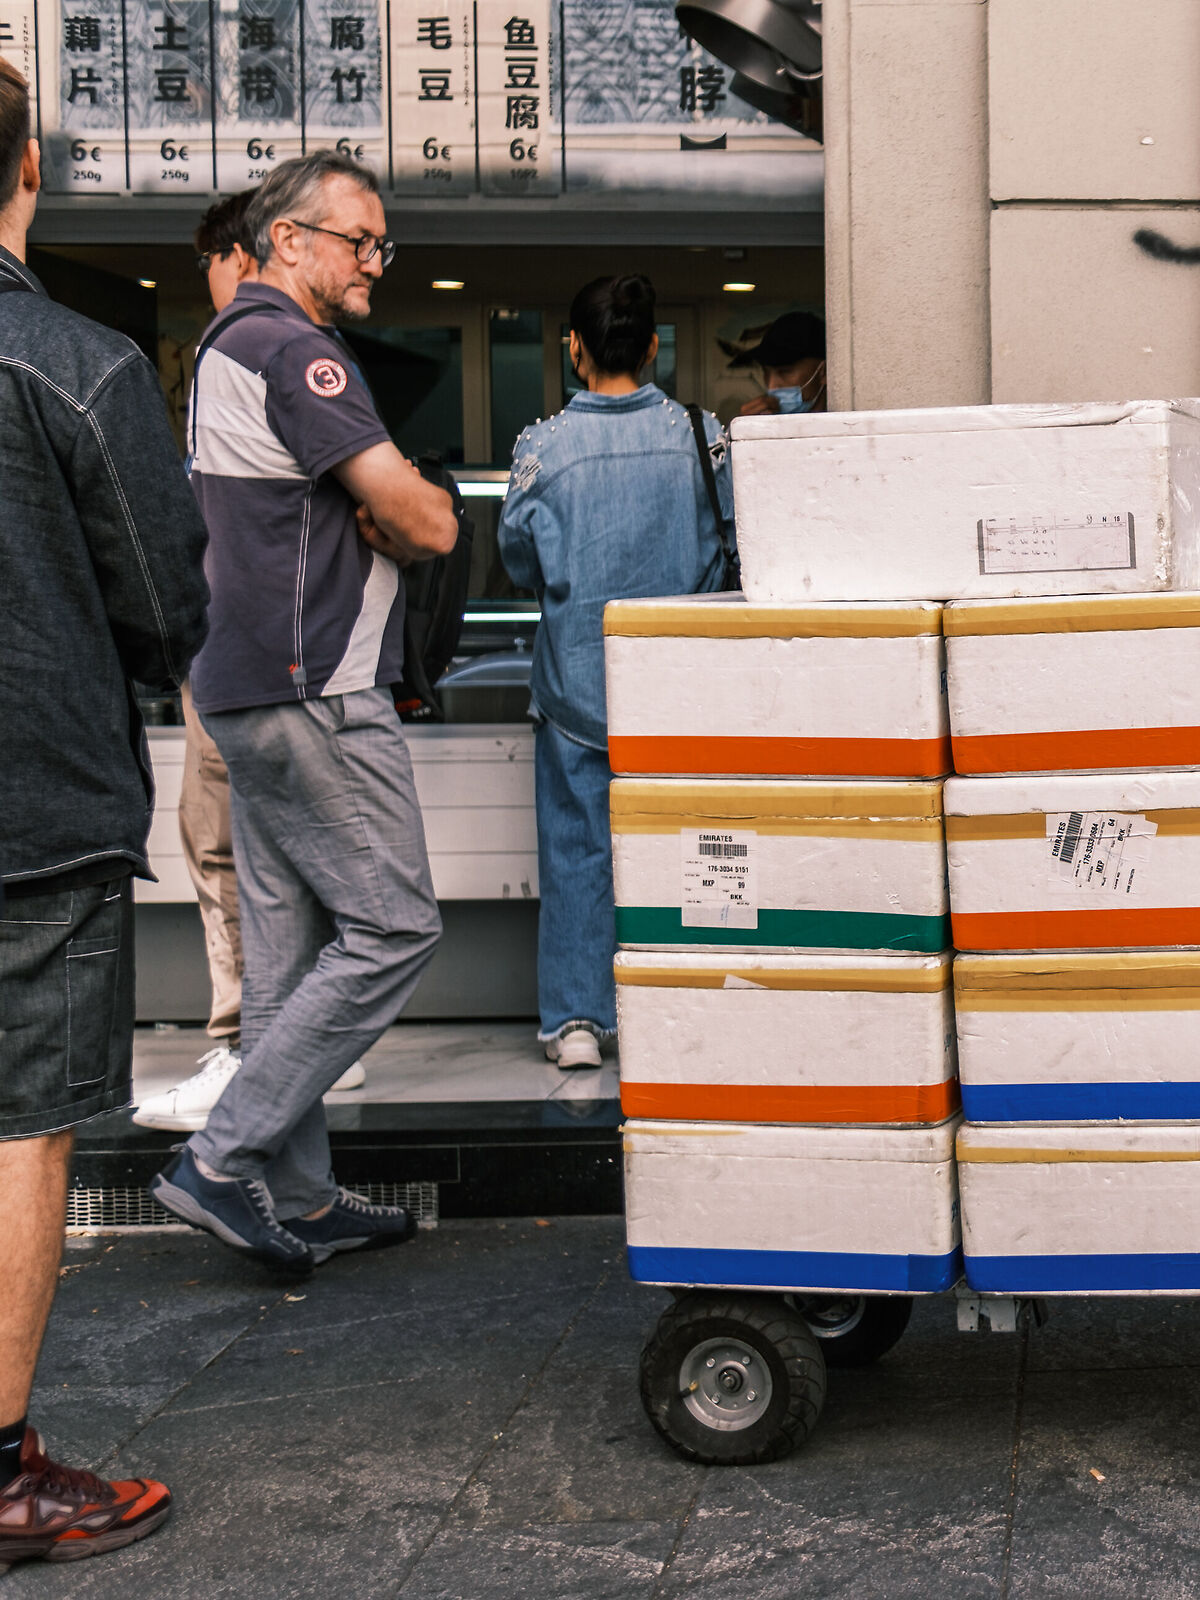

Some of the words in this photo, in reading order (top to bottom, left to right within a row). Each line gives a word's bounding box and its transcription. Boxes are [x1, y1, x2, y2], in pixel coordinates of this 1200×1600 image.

[65, 16, 102, 104] 藕片
[153, 16, 190, 102] 土豆
[330, 15, 366, 103] 腐竹
[417, 16, 453, 101] 毛豆
[504, 16, 539, 129] 鱼豆腐
[71, 139, 101, 162] 6€
[160, 139, 189, 161] 6€
[247, 138, 275, 160] 6€
[423, 137, 451, 161] 6€
[510, 138, 538, 161] 6€
[73, 170, 102, 182] 250g
[161, 170, 189, 181] 250g
[699, 834, 733, 842] EMIRATES
[1052, 821, 1067, 857] EMIRATES
[702, 879, 715, 887] MXP
